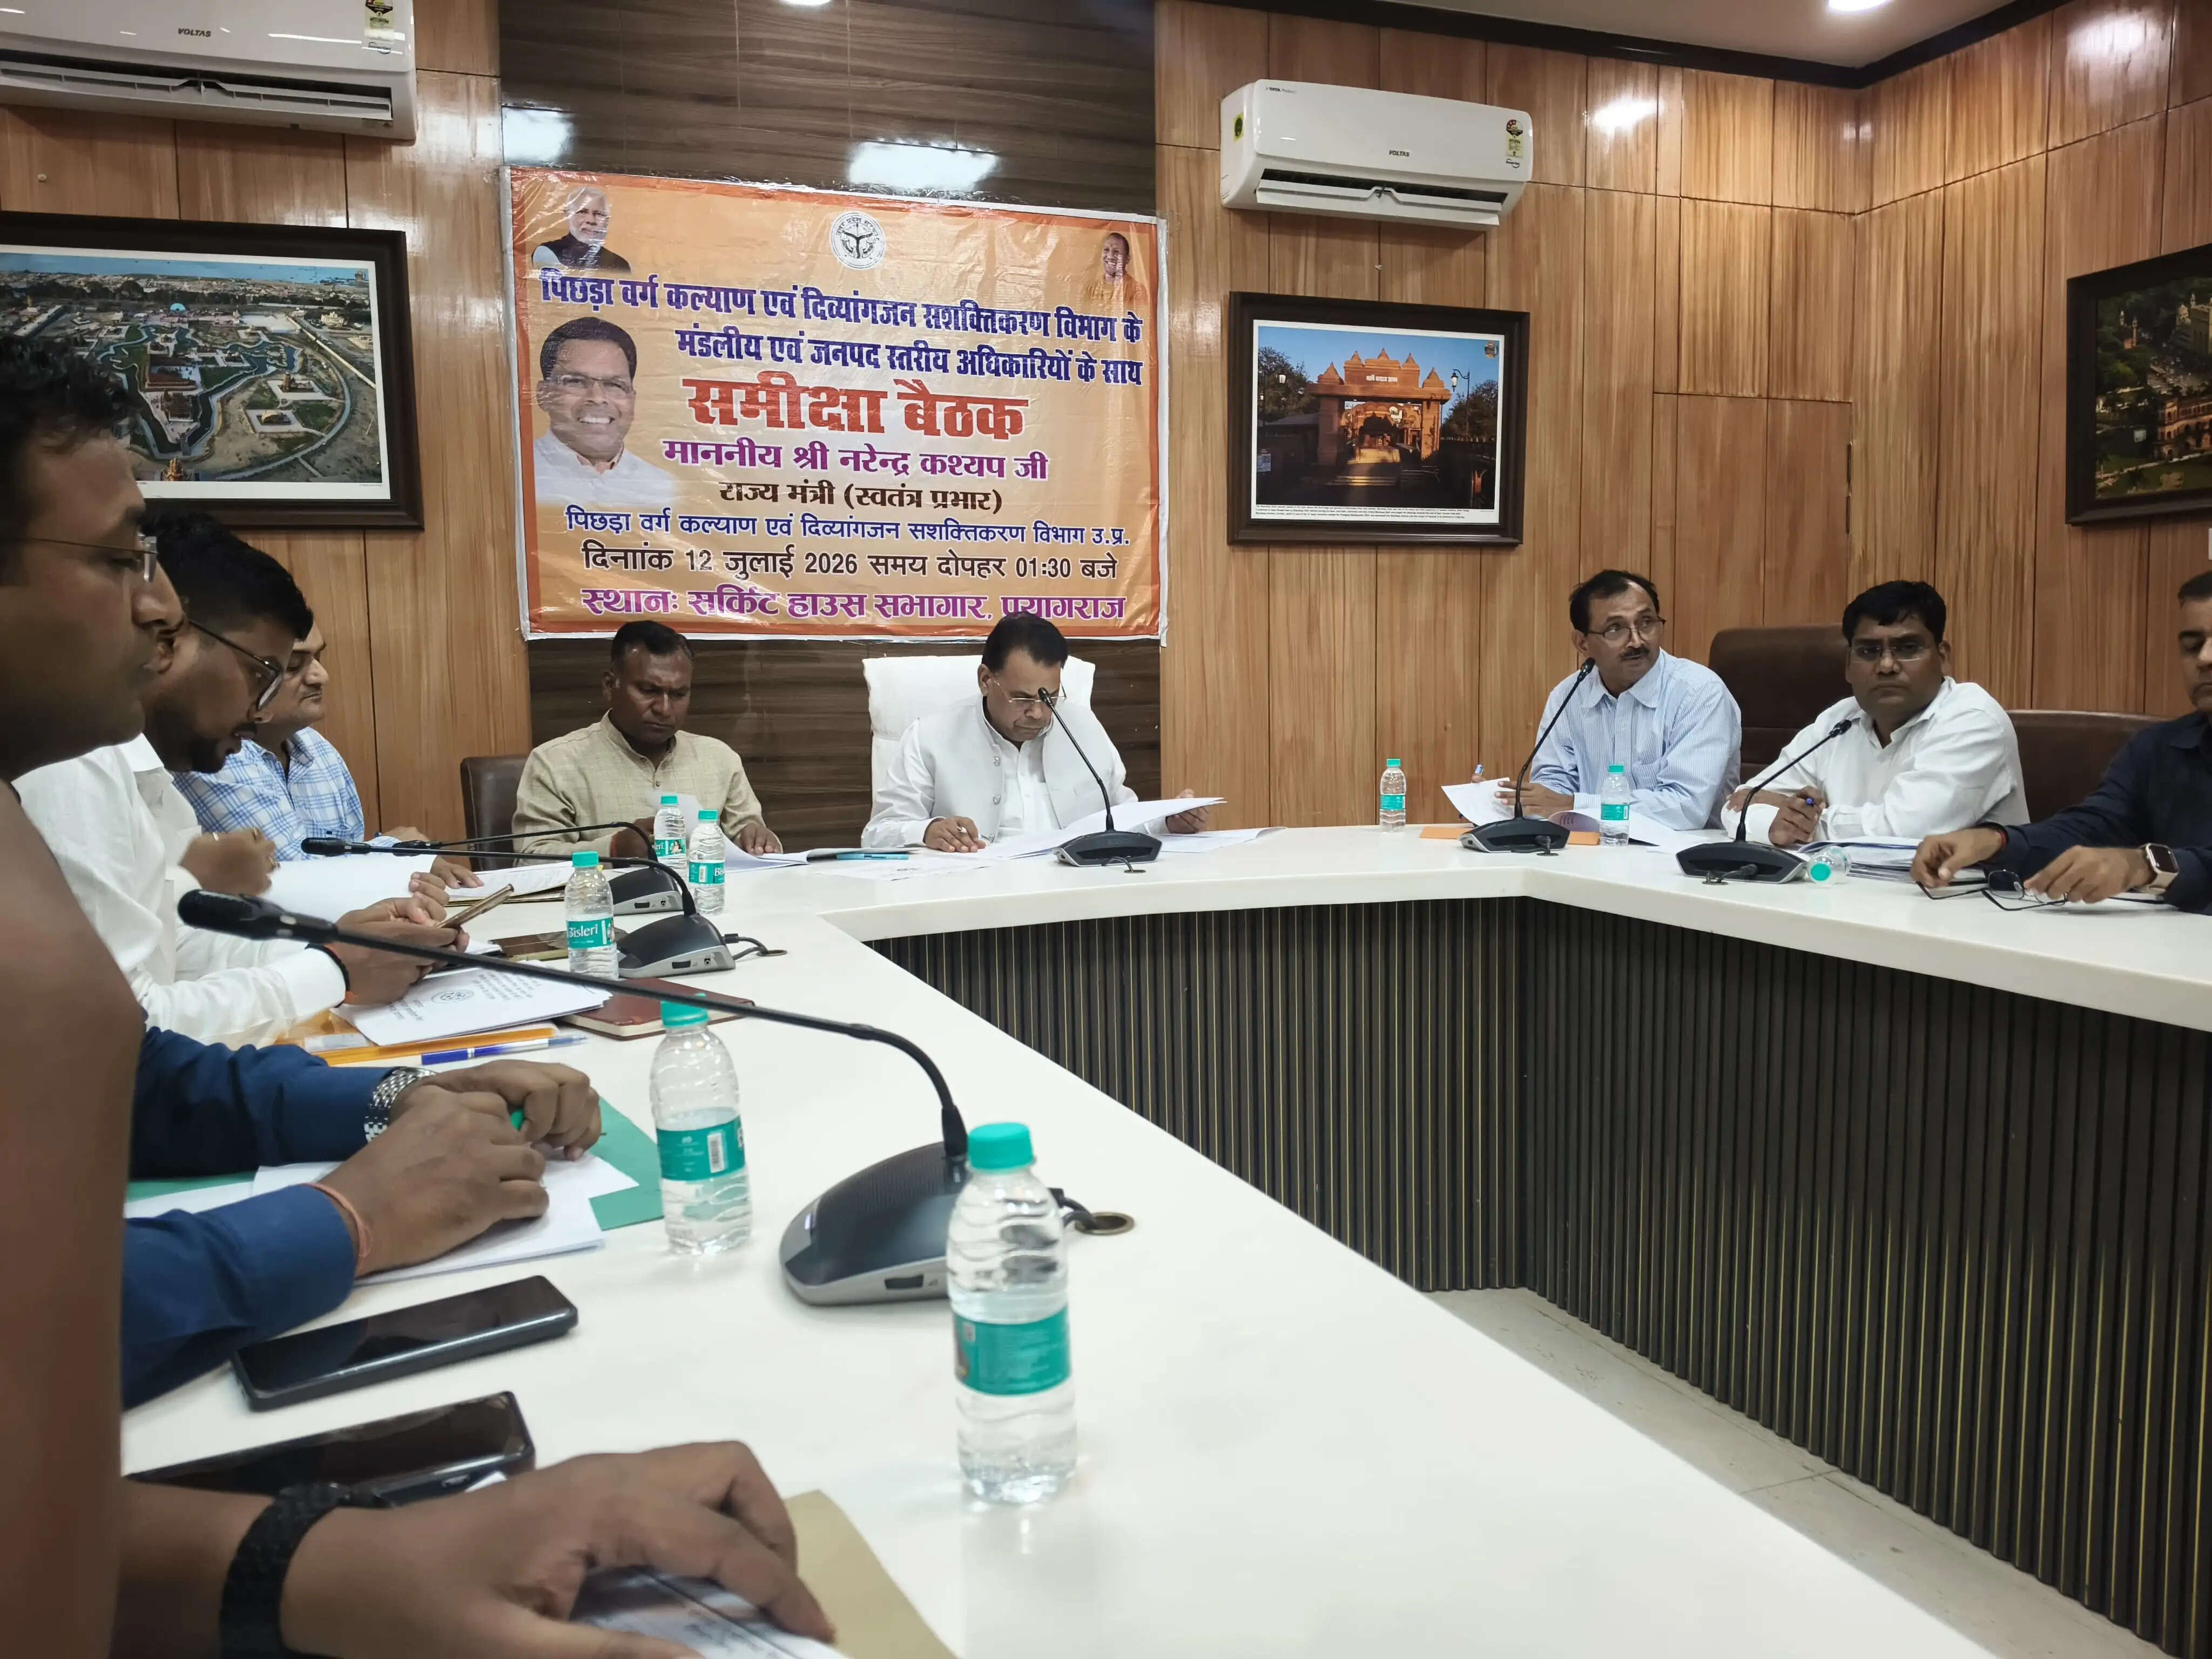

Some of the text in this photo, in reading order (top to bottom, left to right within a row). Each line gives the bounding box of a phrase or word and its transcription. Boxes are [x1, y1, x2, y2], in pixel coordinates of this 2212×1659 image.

[178, 28, 211, 37] VOLTAS
[541, 268, 1143, 343] पिछड़ा वर्ग कल्याण एवं दिव्यांगजन सशक्तिकरण विभाग के
[676, 322, 1143, 385] मंडलीय एवं जनपद स्तरीय अधिकारियों के साथ
[683, 370, 1028, 440] समीक्षा बैठक
[662, 437, 1048, 480] माननीय श्री नरेन्द्र कश्यप जी
[719, 479, 1002, 514] राज्य मंत्री (स्वतंत्र प्रभार)
[565, 505, 1129, 545] पिछड़ा वर्ग कल्याण एवं दिव्यांगजन सशक्तिकरण विभाग उ.प्र.
[685, 549, 712, 570] 12
[723, 544, 794, 579] जुलाई
[805, 552, 858, 574] 2026
[868, 555, 928, 575] समय
[936, 549, 1007, 578] दोपहर
[1016, 557, 1070, 578] 01:30
[1080, 551, 1117, 578] बजे
[787, 594, 867, 617] हाउस
[873, 595, 993, 620] सभागार,
